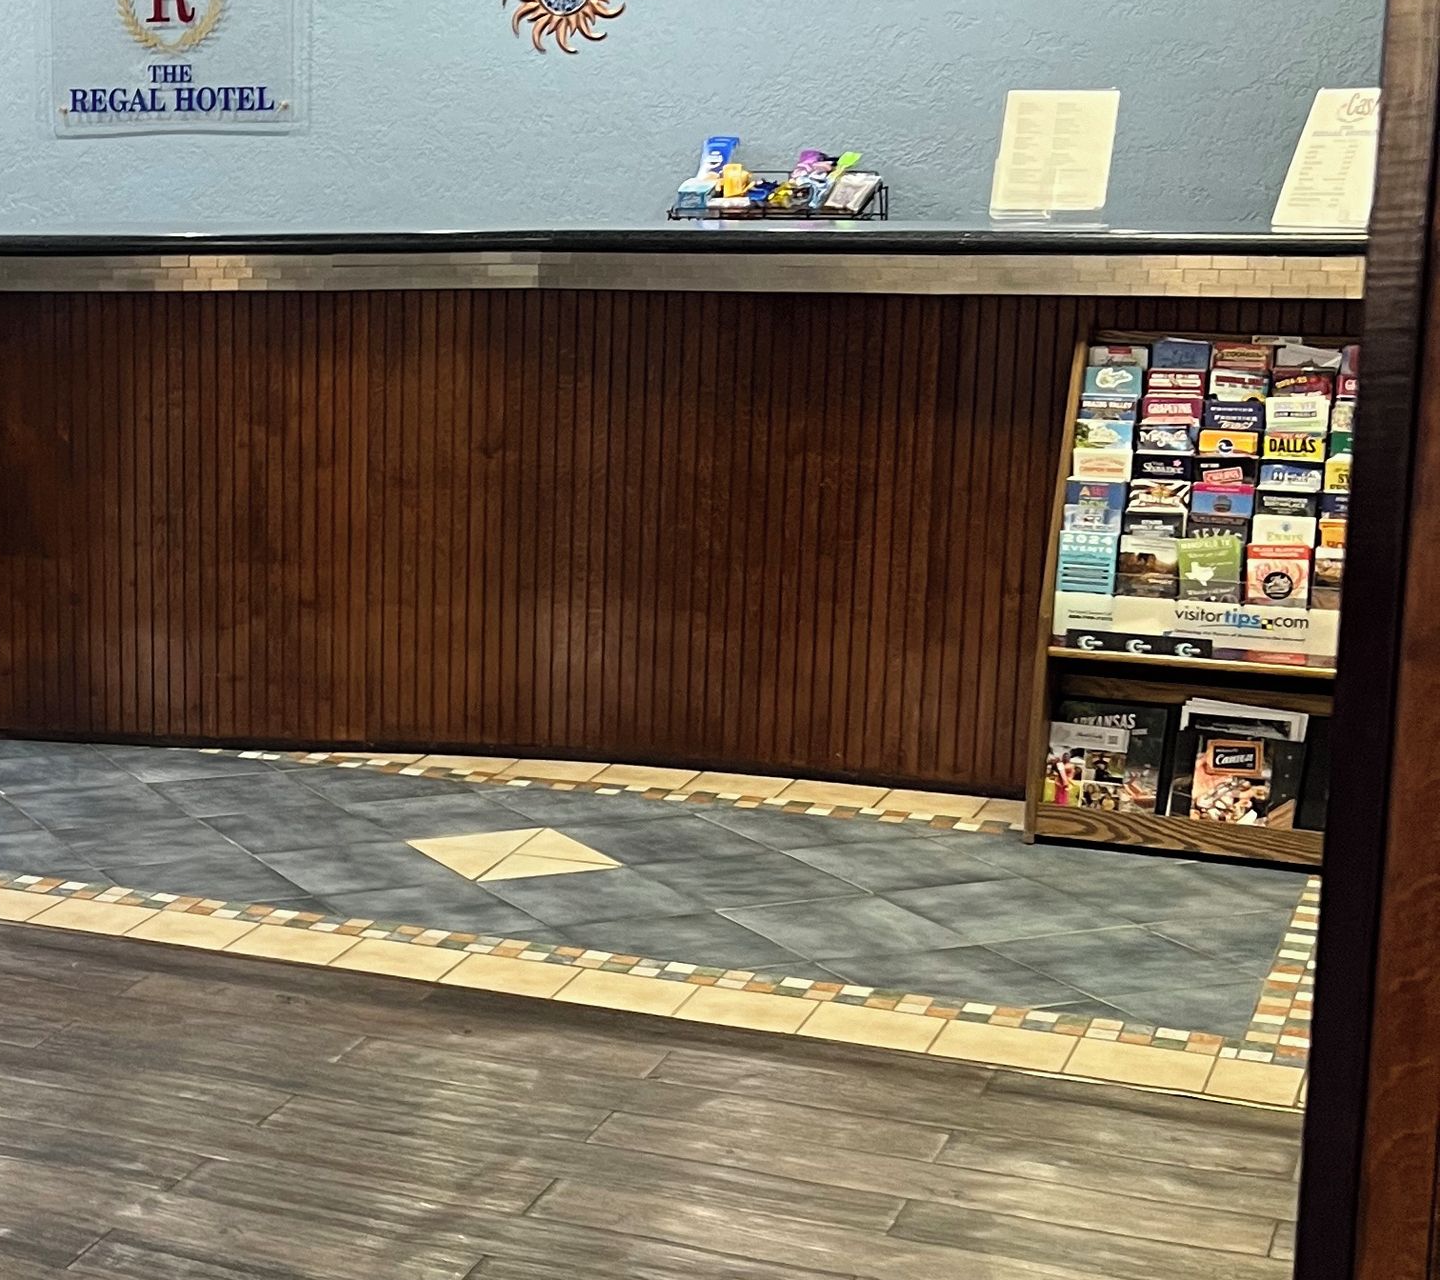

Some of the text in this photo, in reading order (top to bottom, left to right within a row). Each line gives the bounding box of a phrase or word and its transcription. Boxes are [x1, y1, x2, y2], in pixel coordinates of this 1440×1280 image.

[147, 64, 192, 83] THE
[69, 86, 275, 113] REGAL HOTEL
[1346, 92, 1380, 116] Cas
[1269, 438, 1316, 453] DALLAS
[1062, 533, 1113, 545] 2024
